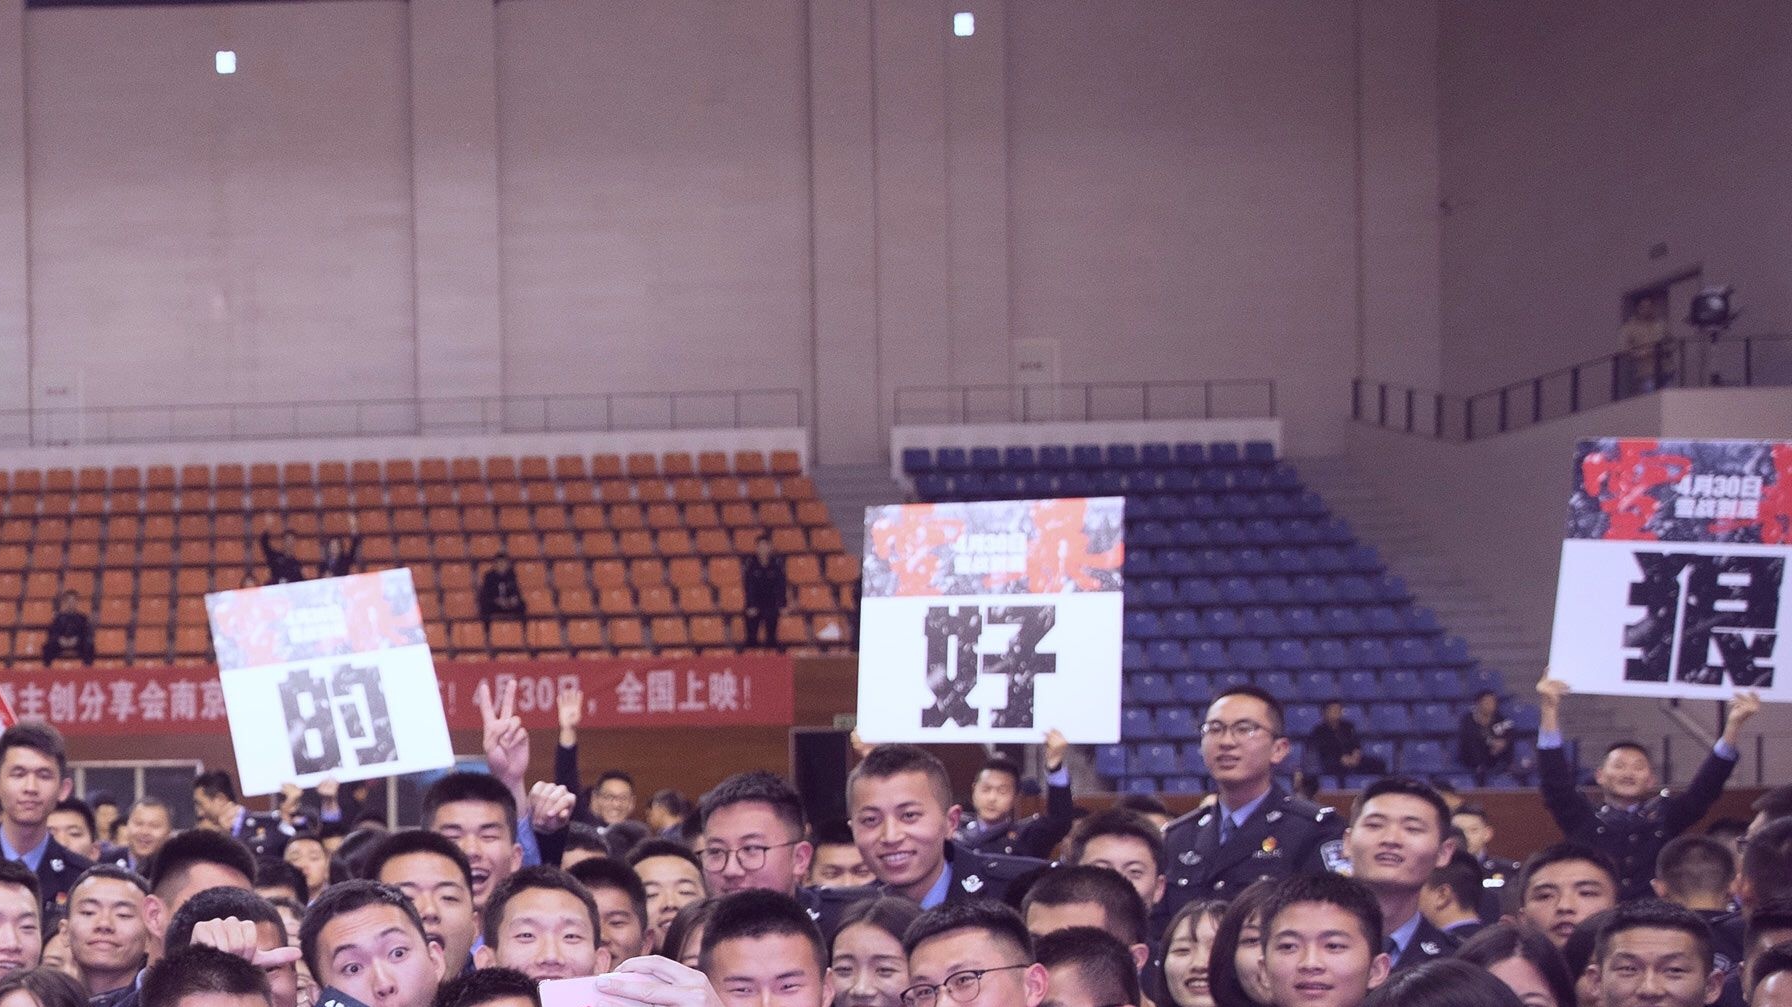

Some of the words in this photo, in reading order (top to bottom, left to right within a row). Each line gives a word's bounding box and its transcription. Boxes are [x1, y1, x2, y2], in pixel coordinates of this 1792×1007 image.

[921, 604, 1057, 729] 好
[1623, 550, 1787, 687] 狠
[278, 663, 400, 776] 的
